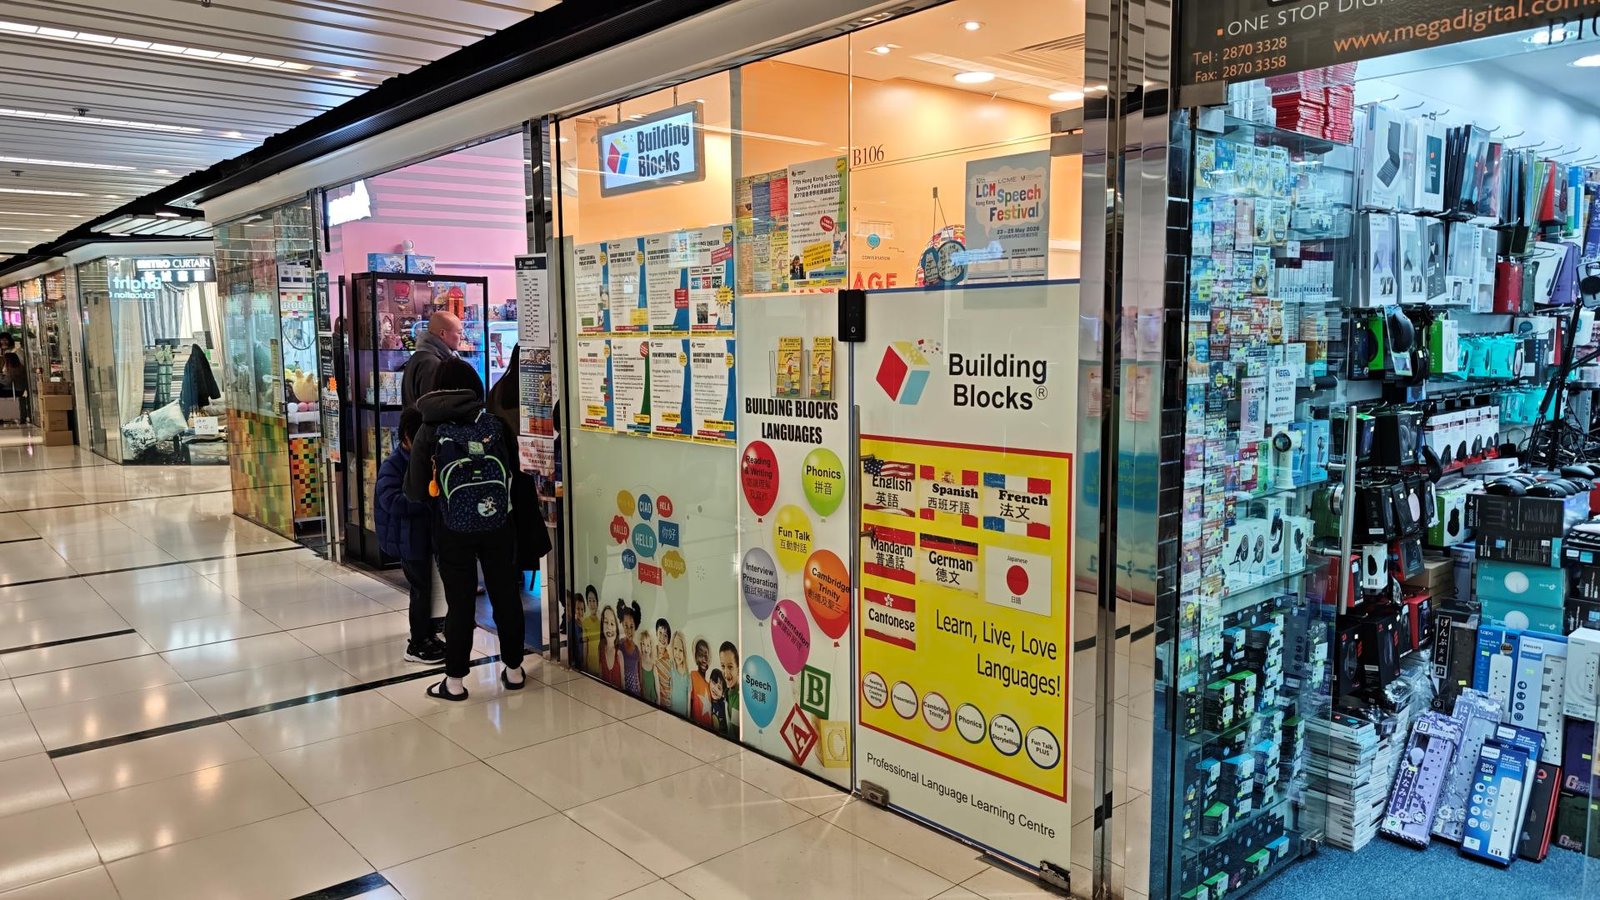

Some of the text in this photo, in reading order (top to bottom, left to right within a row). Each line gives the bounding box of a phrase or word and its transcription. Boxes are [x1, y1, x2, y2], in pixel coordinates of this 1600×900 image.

[1227, 15, 1269, 36] ONE
[1278, 1, 1329, 26] STOP
[1222, 43, 1253, 61] 2870
[1256, 36, 1288, 55] 3328
[1195, 55, 1287, 84] Fax: 2870 3358
[637, 122, 690, 154] Building
[638, 150, 680, 178] Blocks
[853, 144, 885, 166] B106
[976, 183, 996, 198] LCM
[997, 184, 1041, 207] Speech
[989, 202, 1039, 222] Festival
[172, 258, 211, 268] CURTAIN
[949, 353, 1047, 384] Building
[745, 398, 838, 420] BUILDING BLOCKS
[761, 422, 822, 444] LANGUAGES
[746, 456, 771, 468] Reading
[751, 468, 772, 480] Writing
[806, 465, 841, 479] Phonics
[814, 481, 833, 495] 拼音
[872, 474, 912, 492] English
[932, 483, 979, 500] Spanish
[640, 501, 651, 513] CIAO
[660, 502, 671, 511] HOLA
[876, 492, 899, 508] 英語
[927, 497, 970, 514] 西班牙語
[998, 490, 1048, 506] French
[999, 503, 1030, 521] 法文
[635, 533, 654, 548] HELLO
[778, 526, 810, 541] Fun Talk
[779, 539, 807, 554] 互動對話
[870, 536, 913, 558] Mandarin
[876, 552, 905, 570] 普通話
[928, 550, 973, 572] German
[1007, 555, 1028, 564] Japanese
[746, 562, 774, 576] Interview
[935, 567, 960, 585] 德文
[743, 573, 778, 589] Preparation
[812, 568, 850, 593] Cambridge
[818, 583, 840, 601] Trinity
[776, 605, 809, 648] Presentation
[868, 608, 915, 632] Cantonese
[936, 609, 1057, 660] Learn, Live, Love
[745, 674, 772, 693] Speech
[977, 653, 1060, 697] Languages!
[807, 673, 824, 707] B
[923, 701, 949, 715] Cambridge
[929, 710, 944, 721] Trinity
[958, 715, 982, 729] Phonics
[994, 722, 1014, 733] Fun Talk
[992, 733, 1019, 747] Storytelling
[1031, 739, 1053, 751] Fun Talk
[1036, 747, 1050, 756] PLUS
[866, 752, 1056, 839] Professional Language Learning Centre
